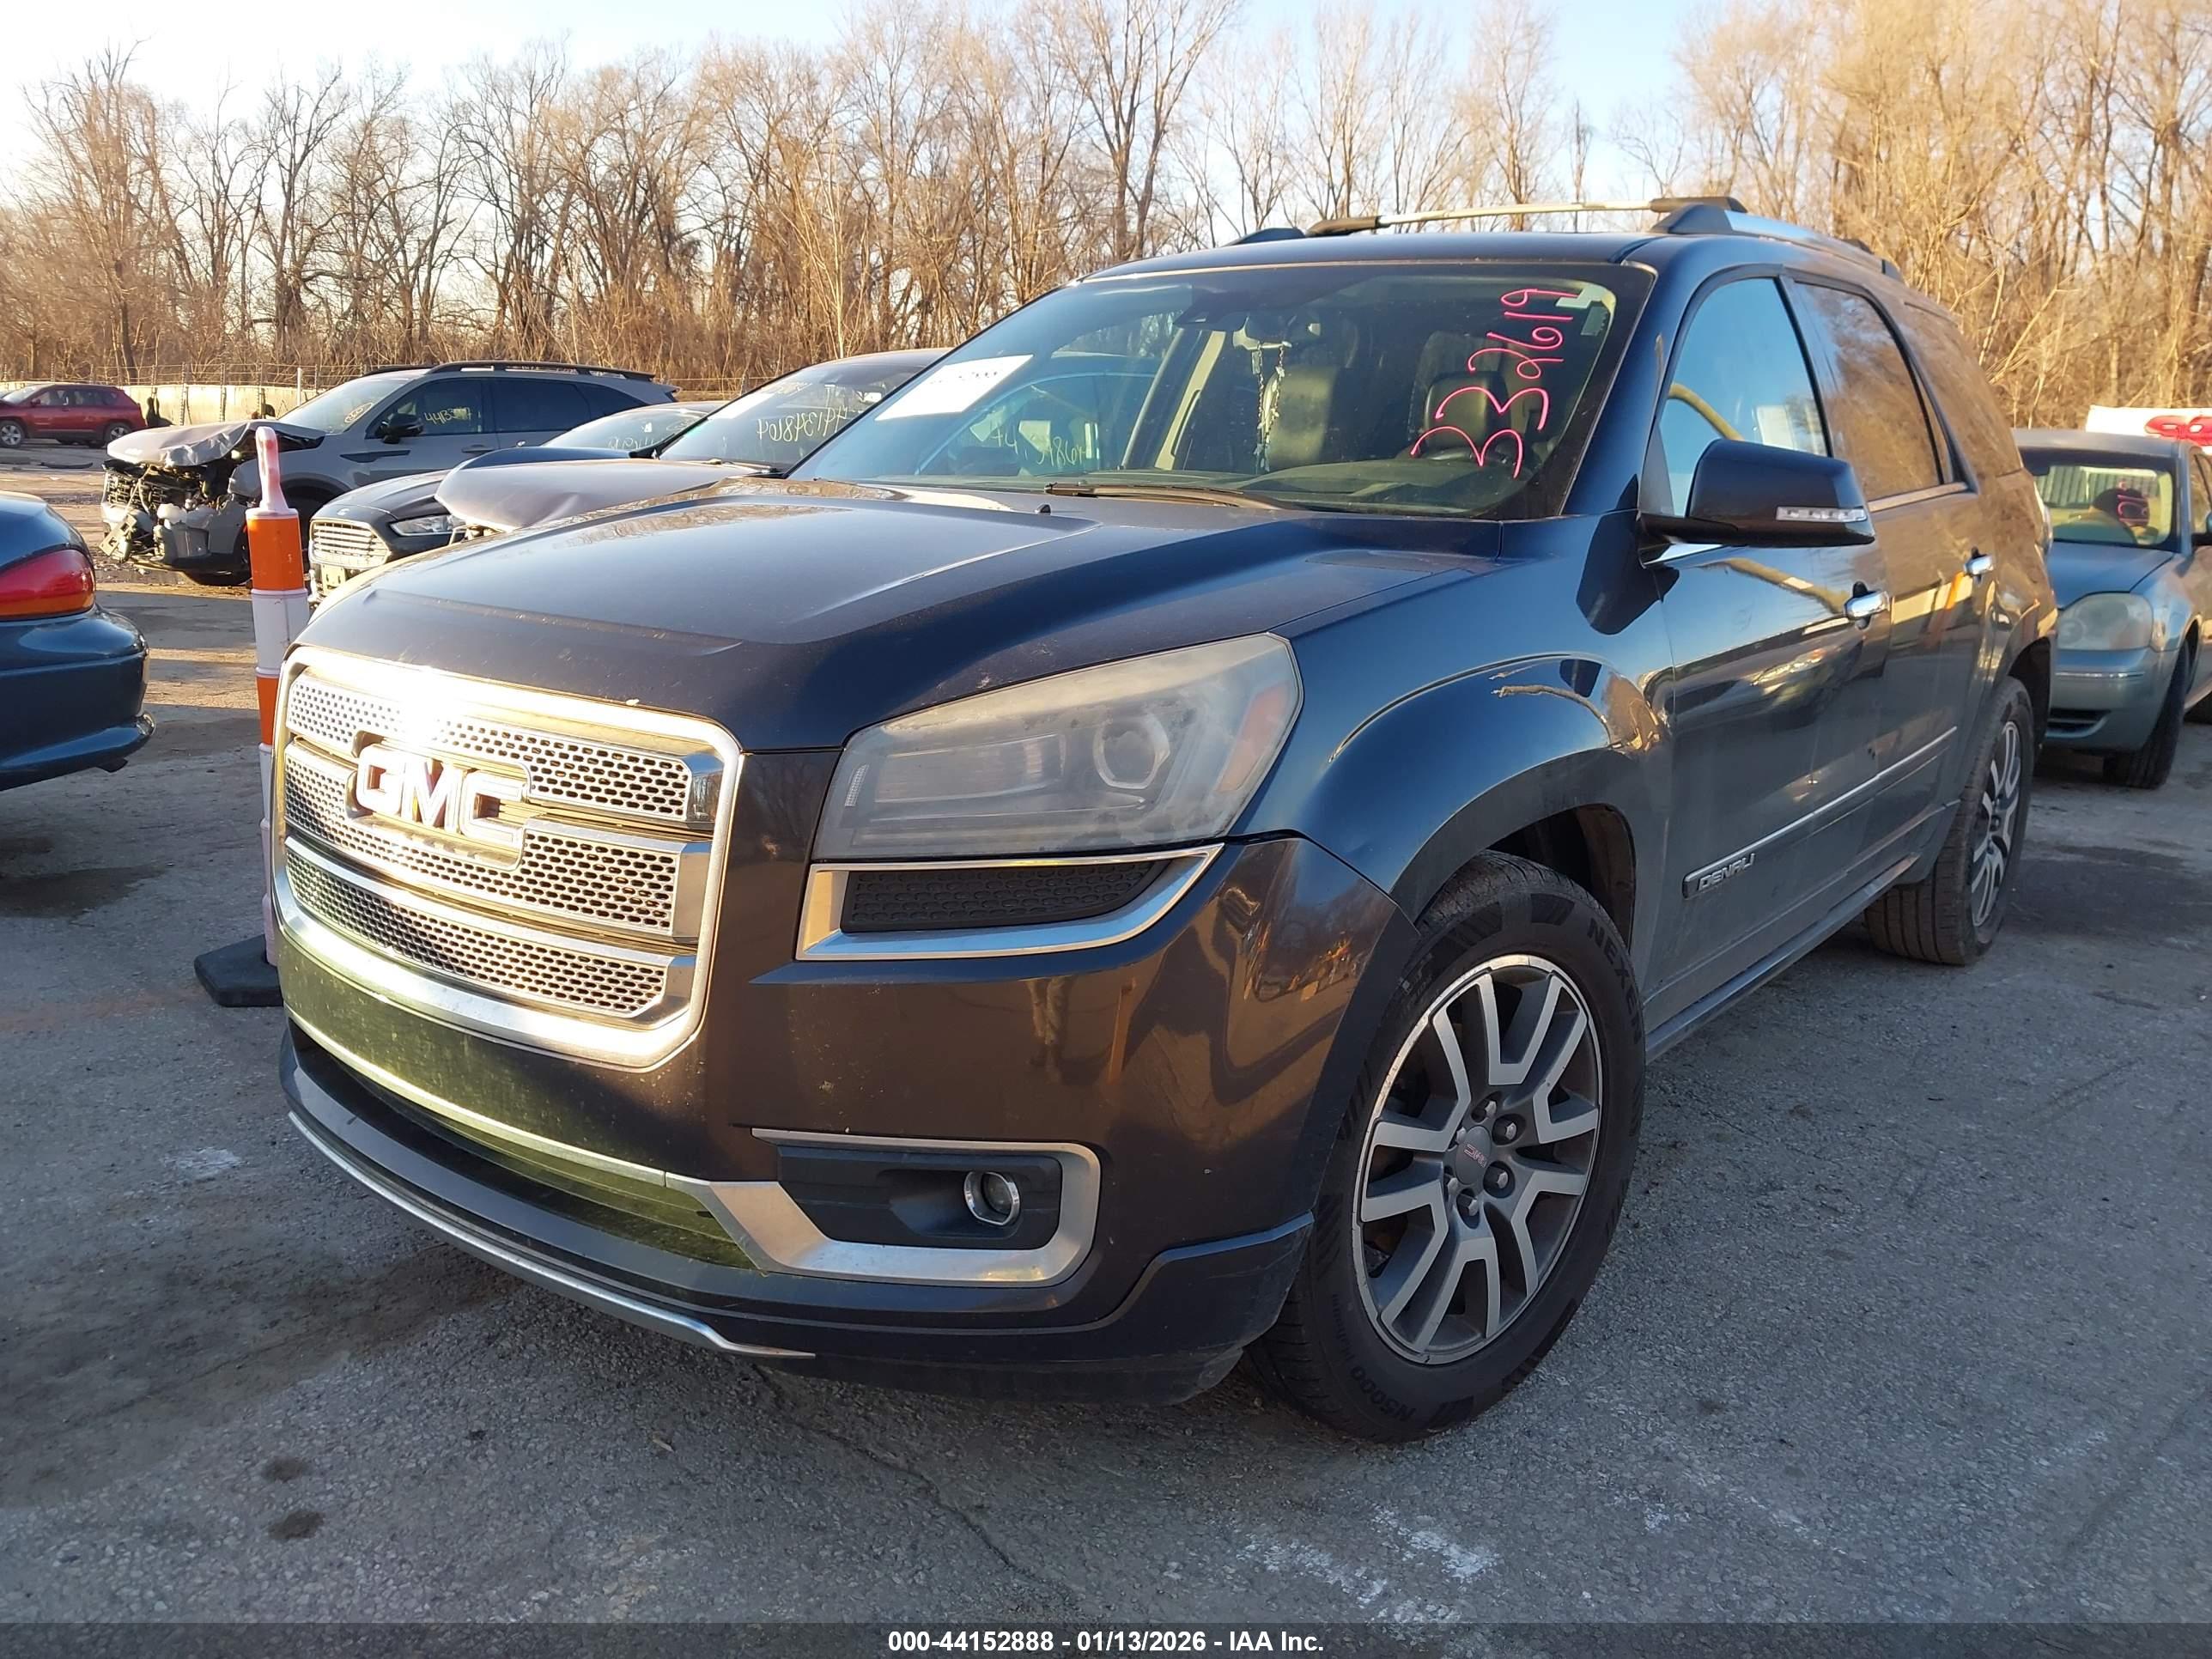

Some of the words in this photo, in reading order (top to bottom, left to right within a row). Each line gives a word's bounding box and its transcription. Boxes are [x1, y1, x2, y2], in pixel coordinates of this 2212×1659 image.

[1411, 288, 1581, 478] 332619
[356, 742, 531, 847] GMC
[1697, 853, 1756, 891] DENALI
[1587, 917, 1643, 1045] NEXEN
[1349, 1365, 1417, 1422] N5000
